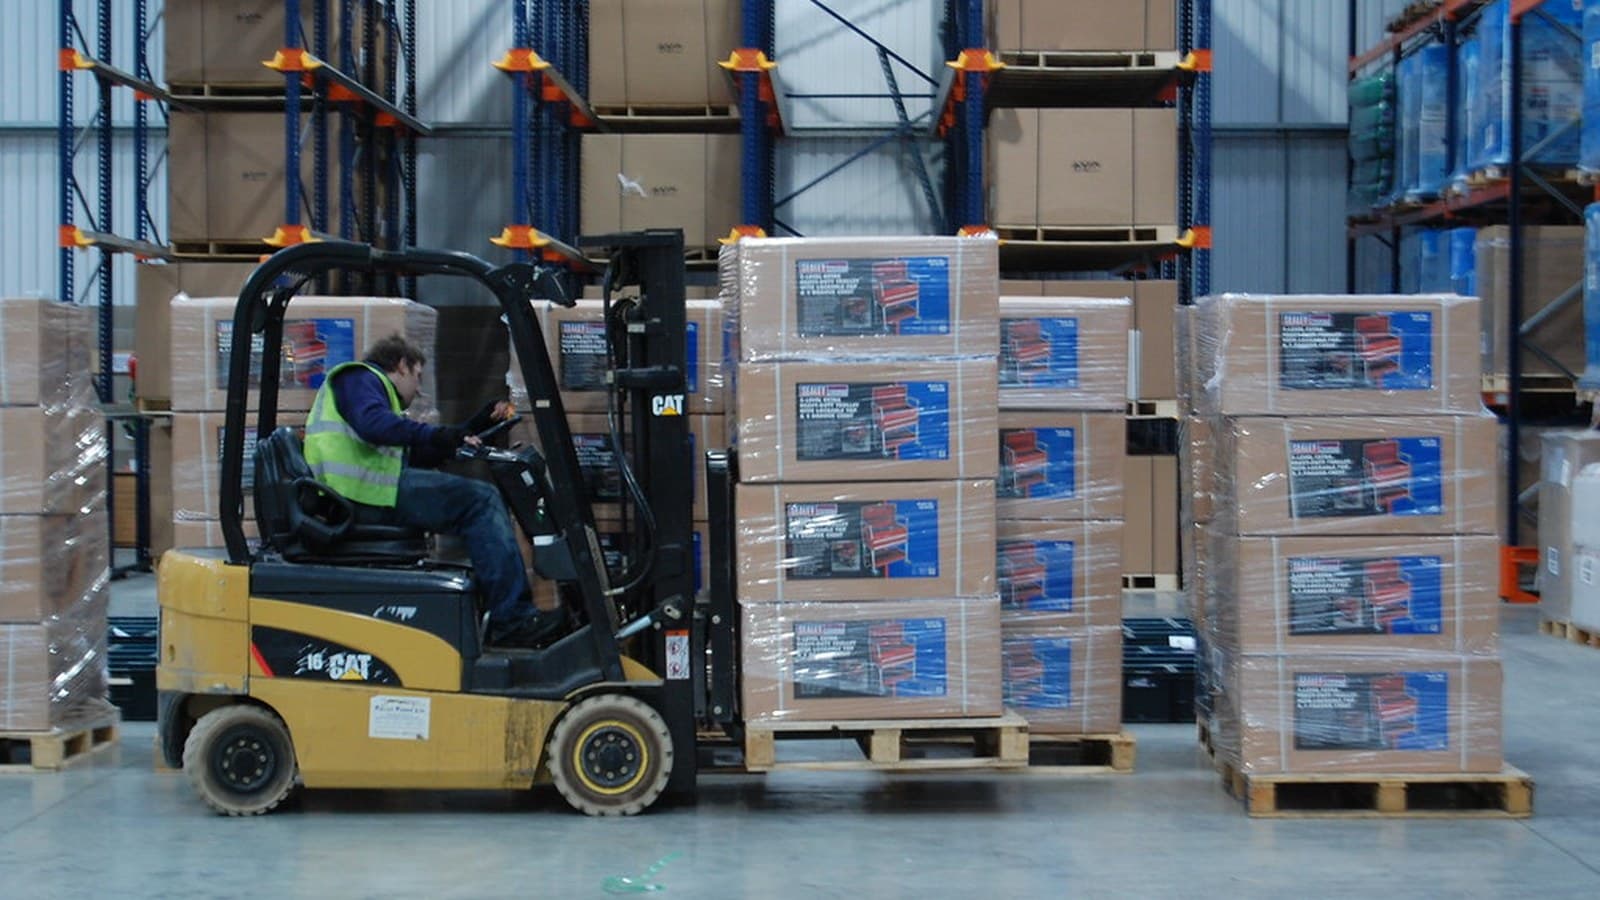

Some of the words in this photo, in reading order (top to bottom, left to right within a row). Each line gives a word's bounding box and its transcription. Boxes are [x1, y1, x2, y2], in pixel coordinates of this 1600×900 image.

[652, 395, 684, 416] CAT
[307, 653, 322, 670] 16
[329, 653, 372, 680] CAT
